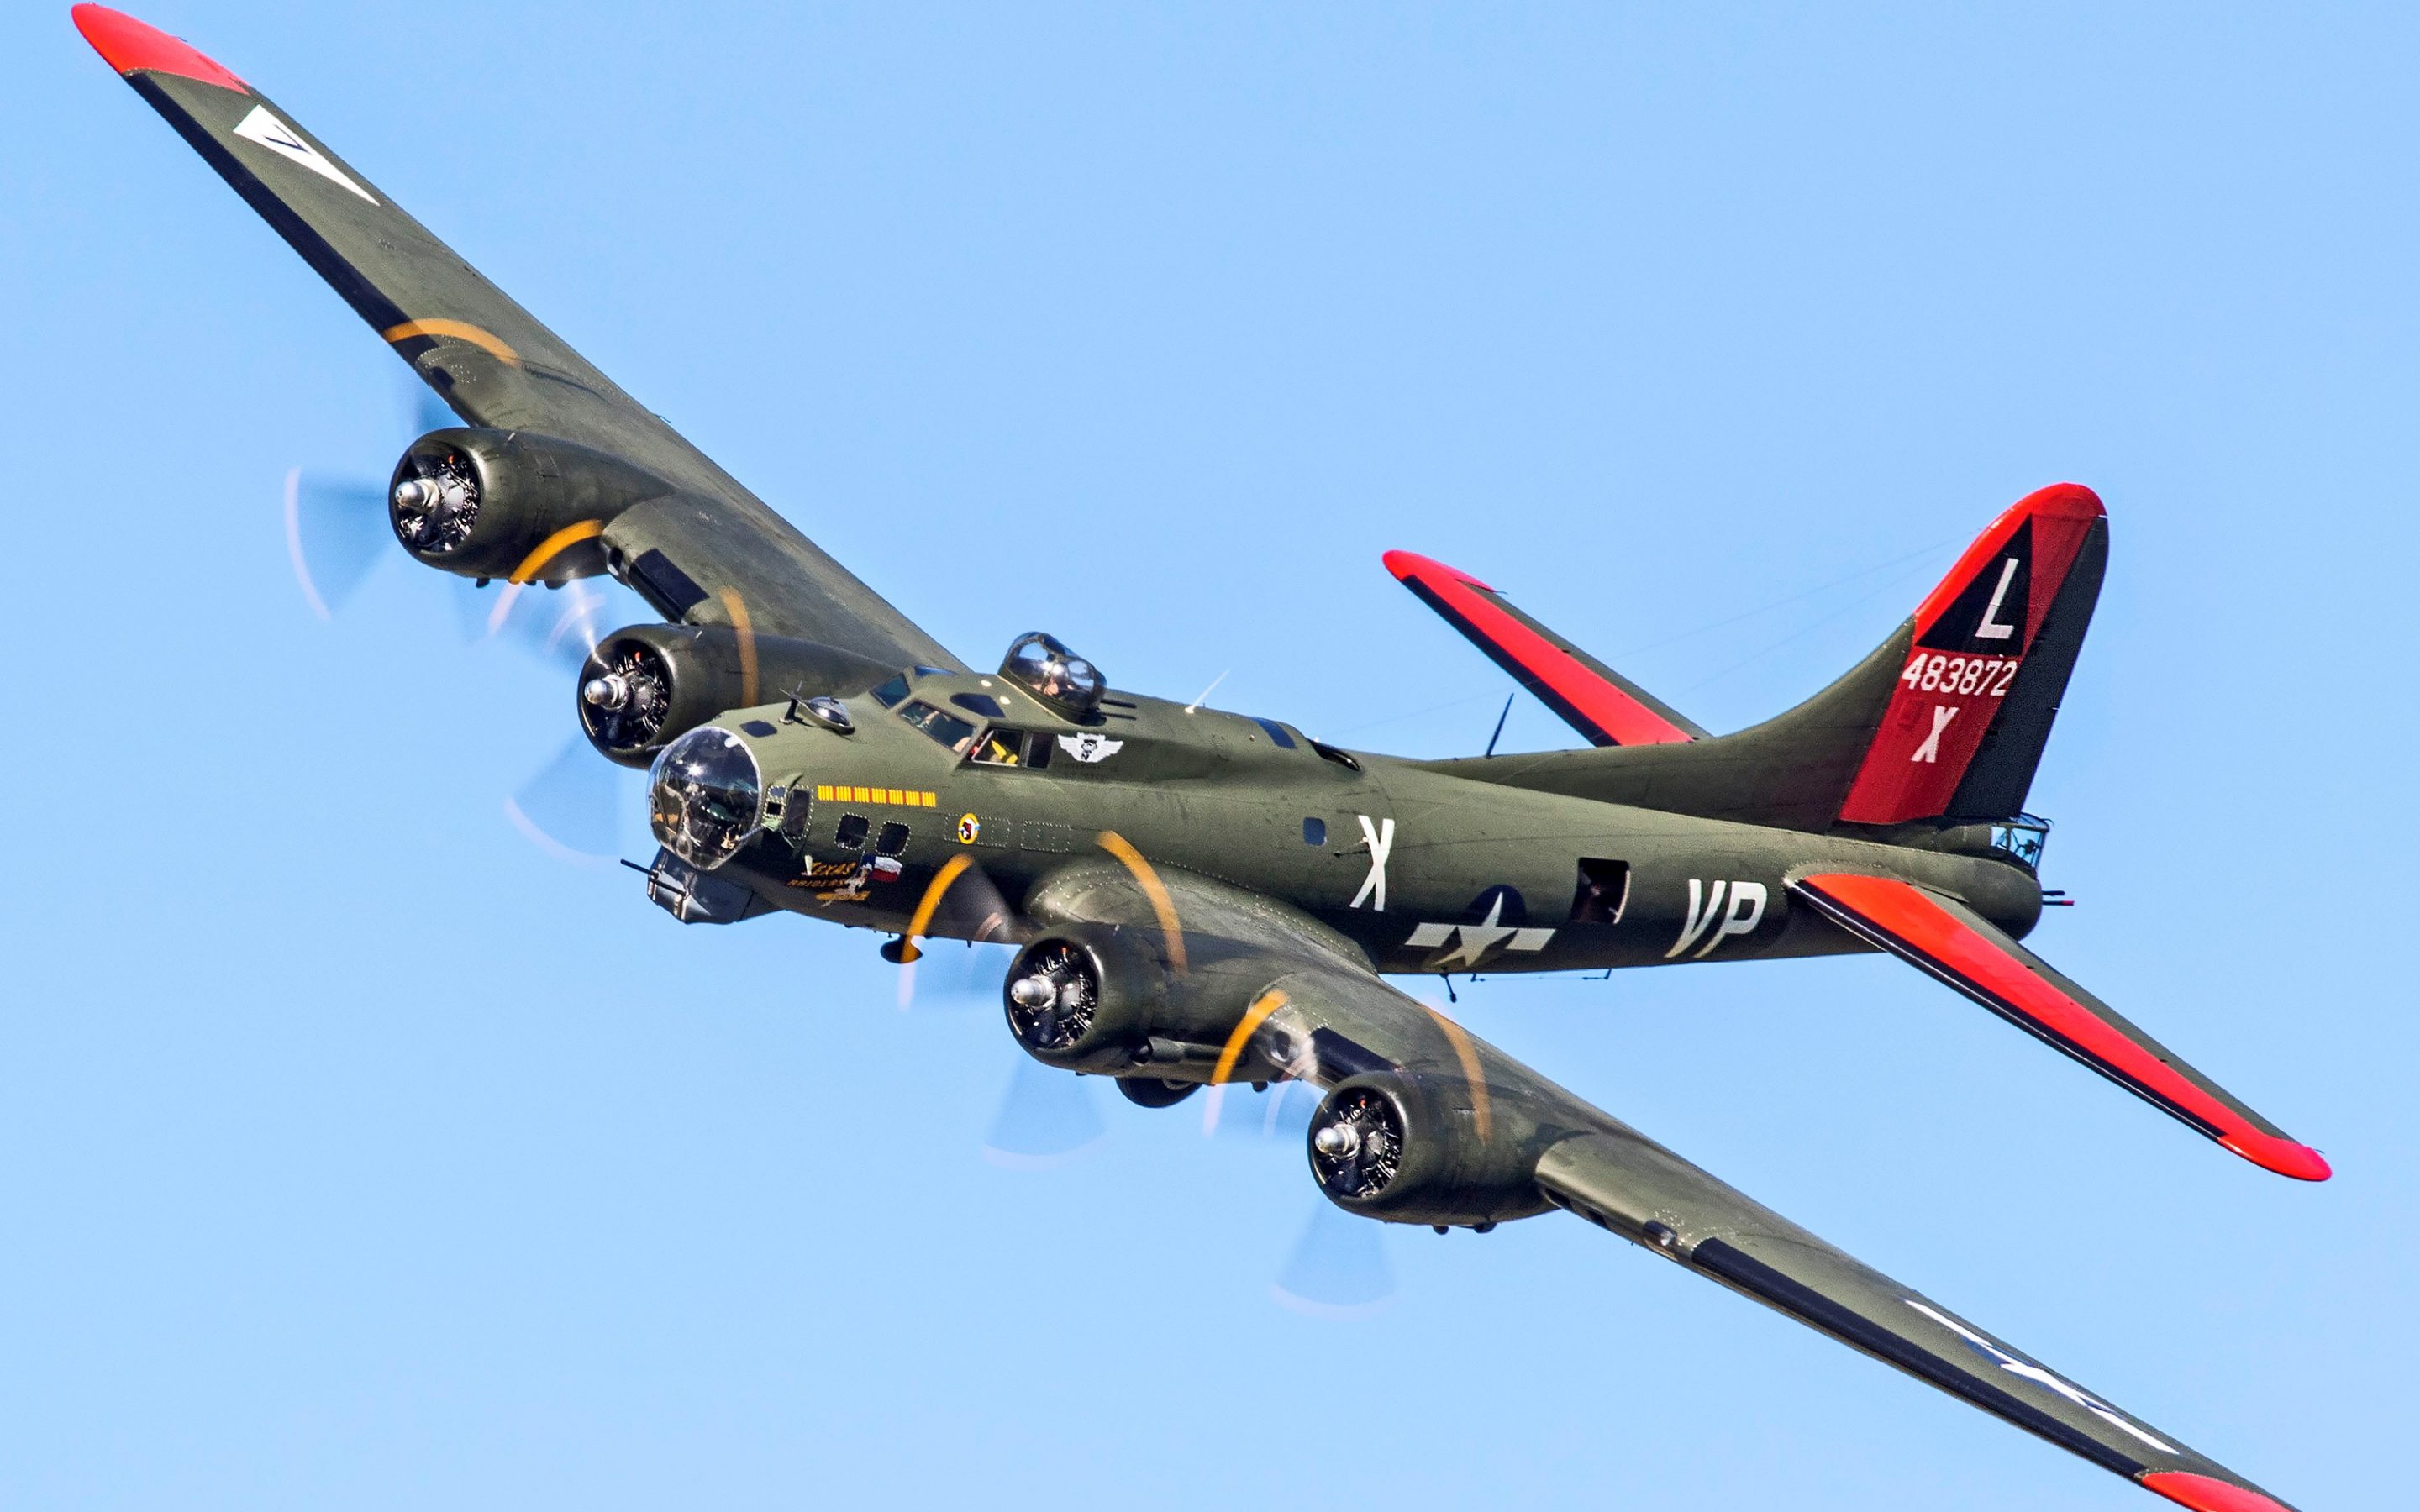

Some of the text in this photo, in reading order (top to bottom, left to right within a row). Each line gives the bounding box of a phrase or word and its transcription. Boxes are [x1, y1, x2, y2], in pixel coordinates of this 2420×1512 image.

[1975, 558, 2018, 639] L
[1902, 653, 2017, 696] 483872
[1911, 706, 1960, 764] X
[1349, 815, 1395, 911] X
[1665, 879, 1768, 958] VP
